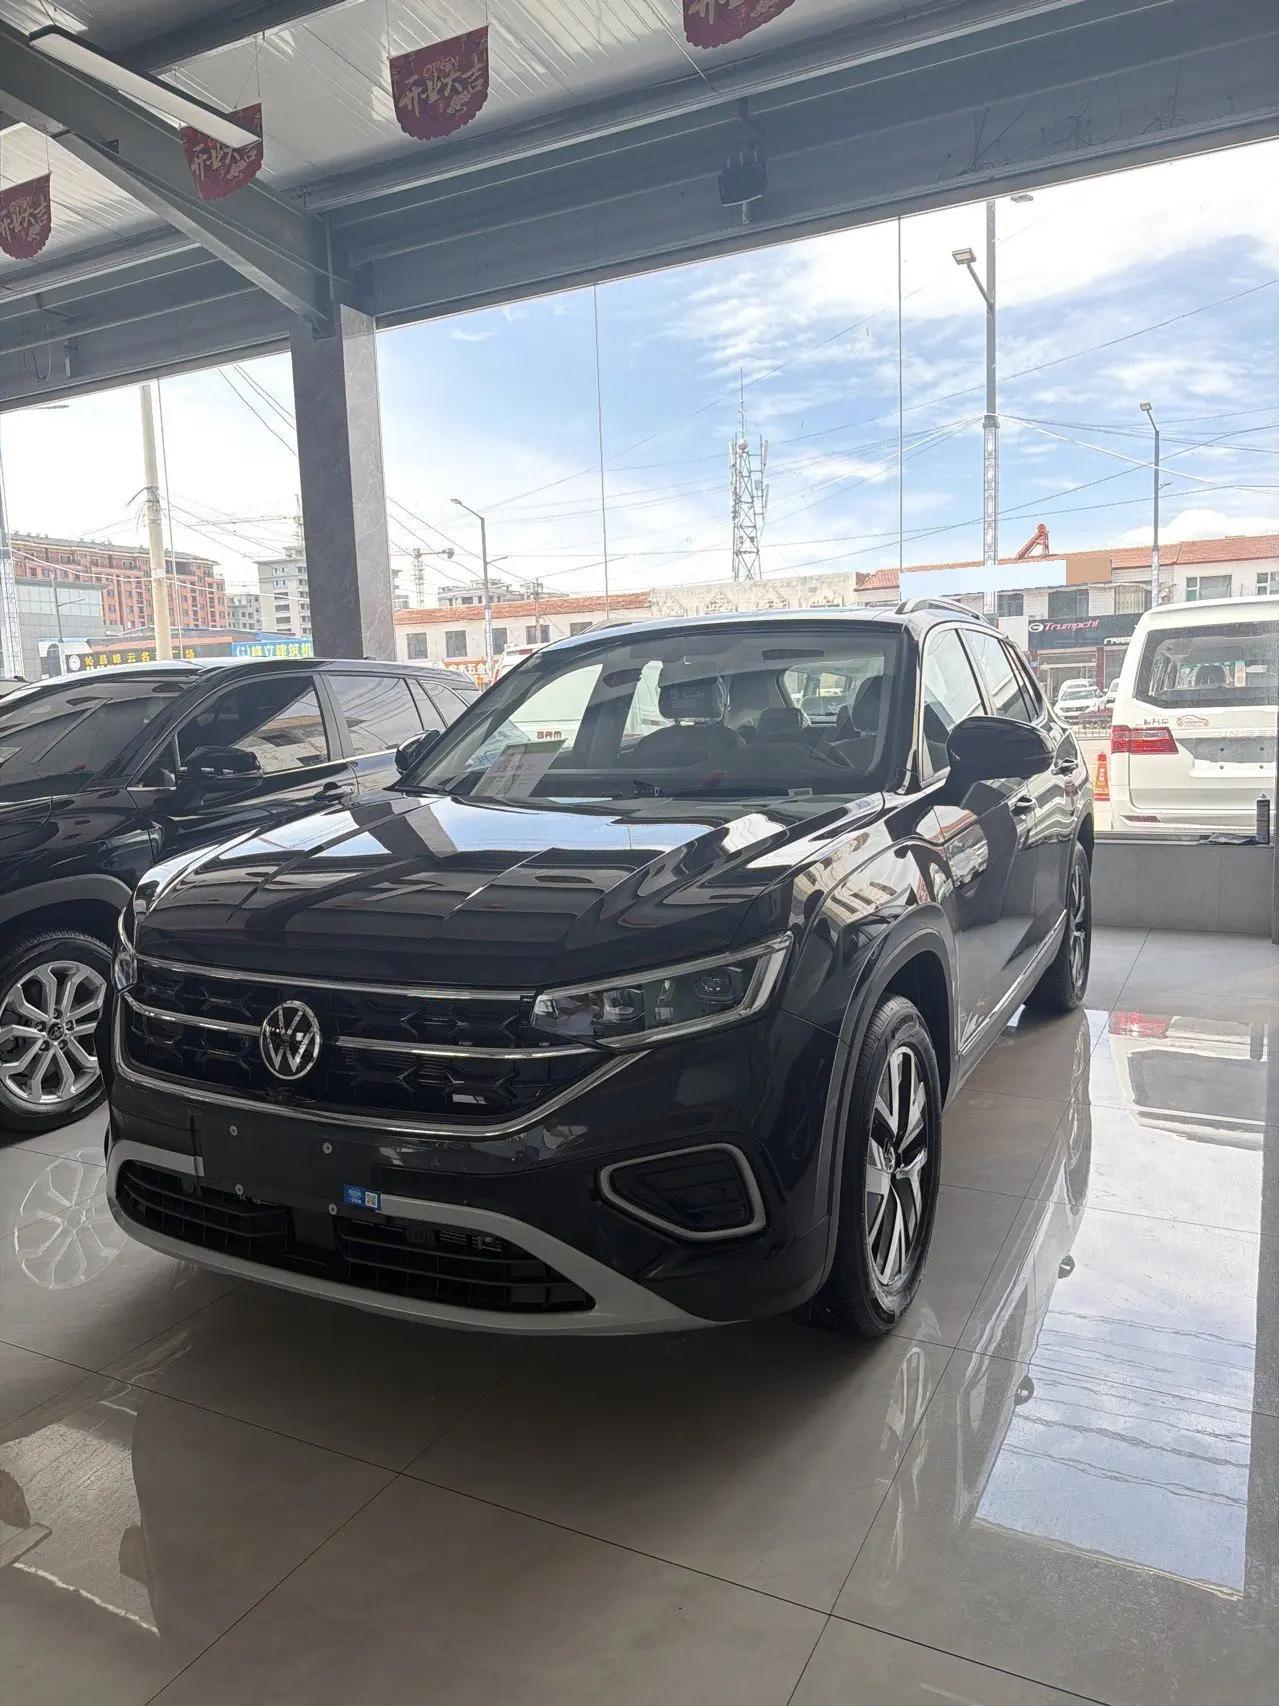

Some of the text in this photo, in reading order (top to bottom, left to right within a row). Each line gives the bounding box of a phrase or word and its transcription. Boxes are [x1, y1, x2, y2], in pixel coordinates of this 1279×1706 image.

[398, 53, 486, 118] 开业大吉
[1043, 619, 1100, 632] Trumpchi
[536, 730, 562, 739] SRM
[261, 1000, 321, 1080] VW
